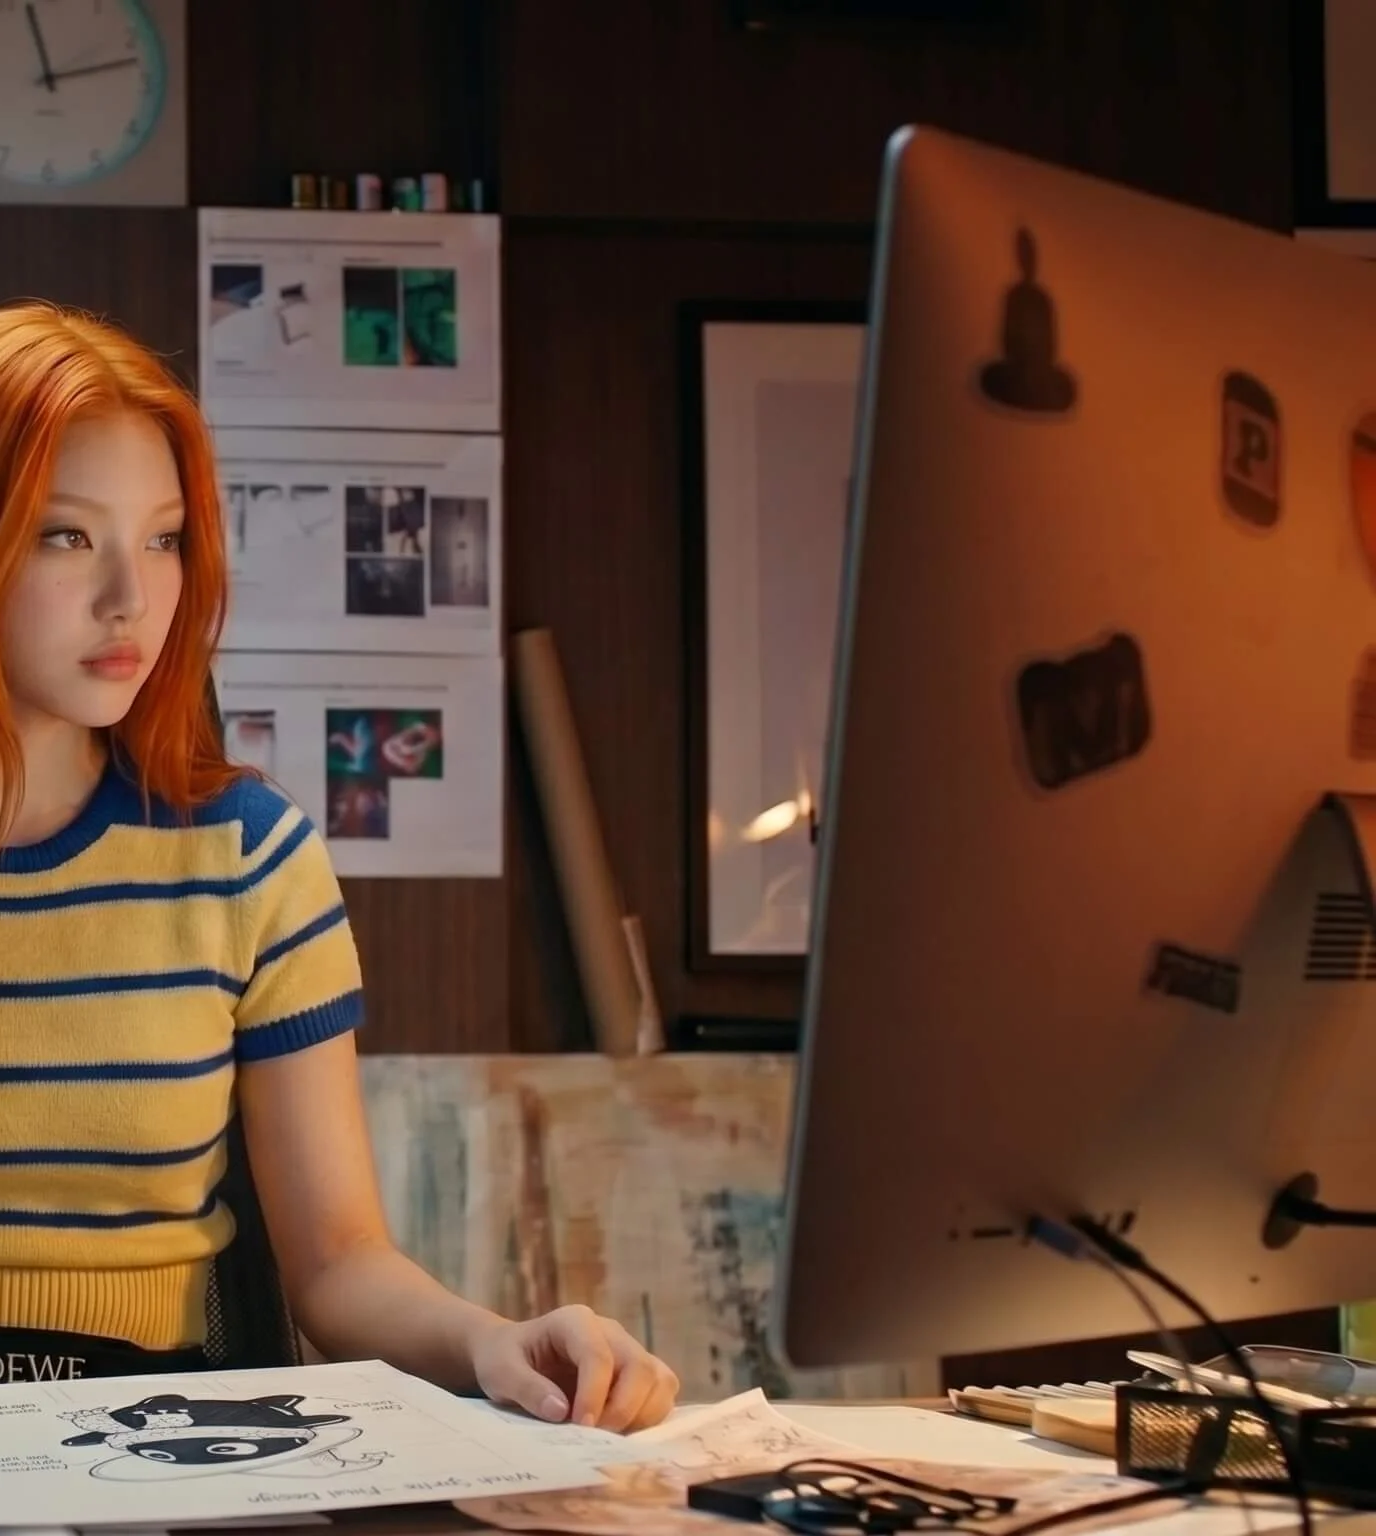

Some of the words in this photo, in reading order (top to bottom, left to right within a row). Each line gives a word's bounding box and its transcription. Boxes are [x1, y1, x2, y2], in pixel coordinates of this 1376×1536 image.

[40, 158, 55, 183] 6
[1233, 417, 1270, 478] P
[247, 1491, 321, 1503] Design
